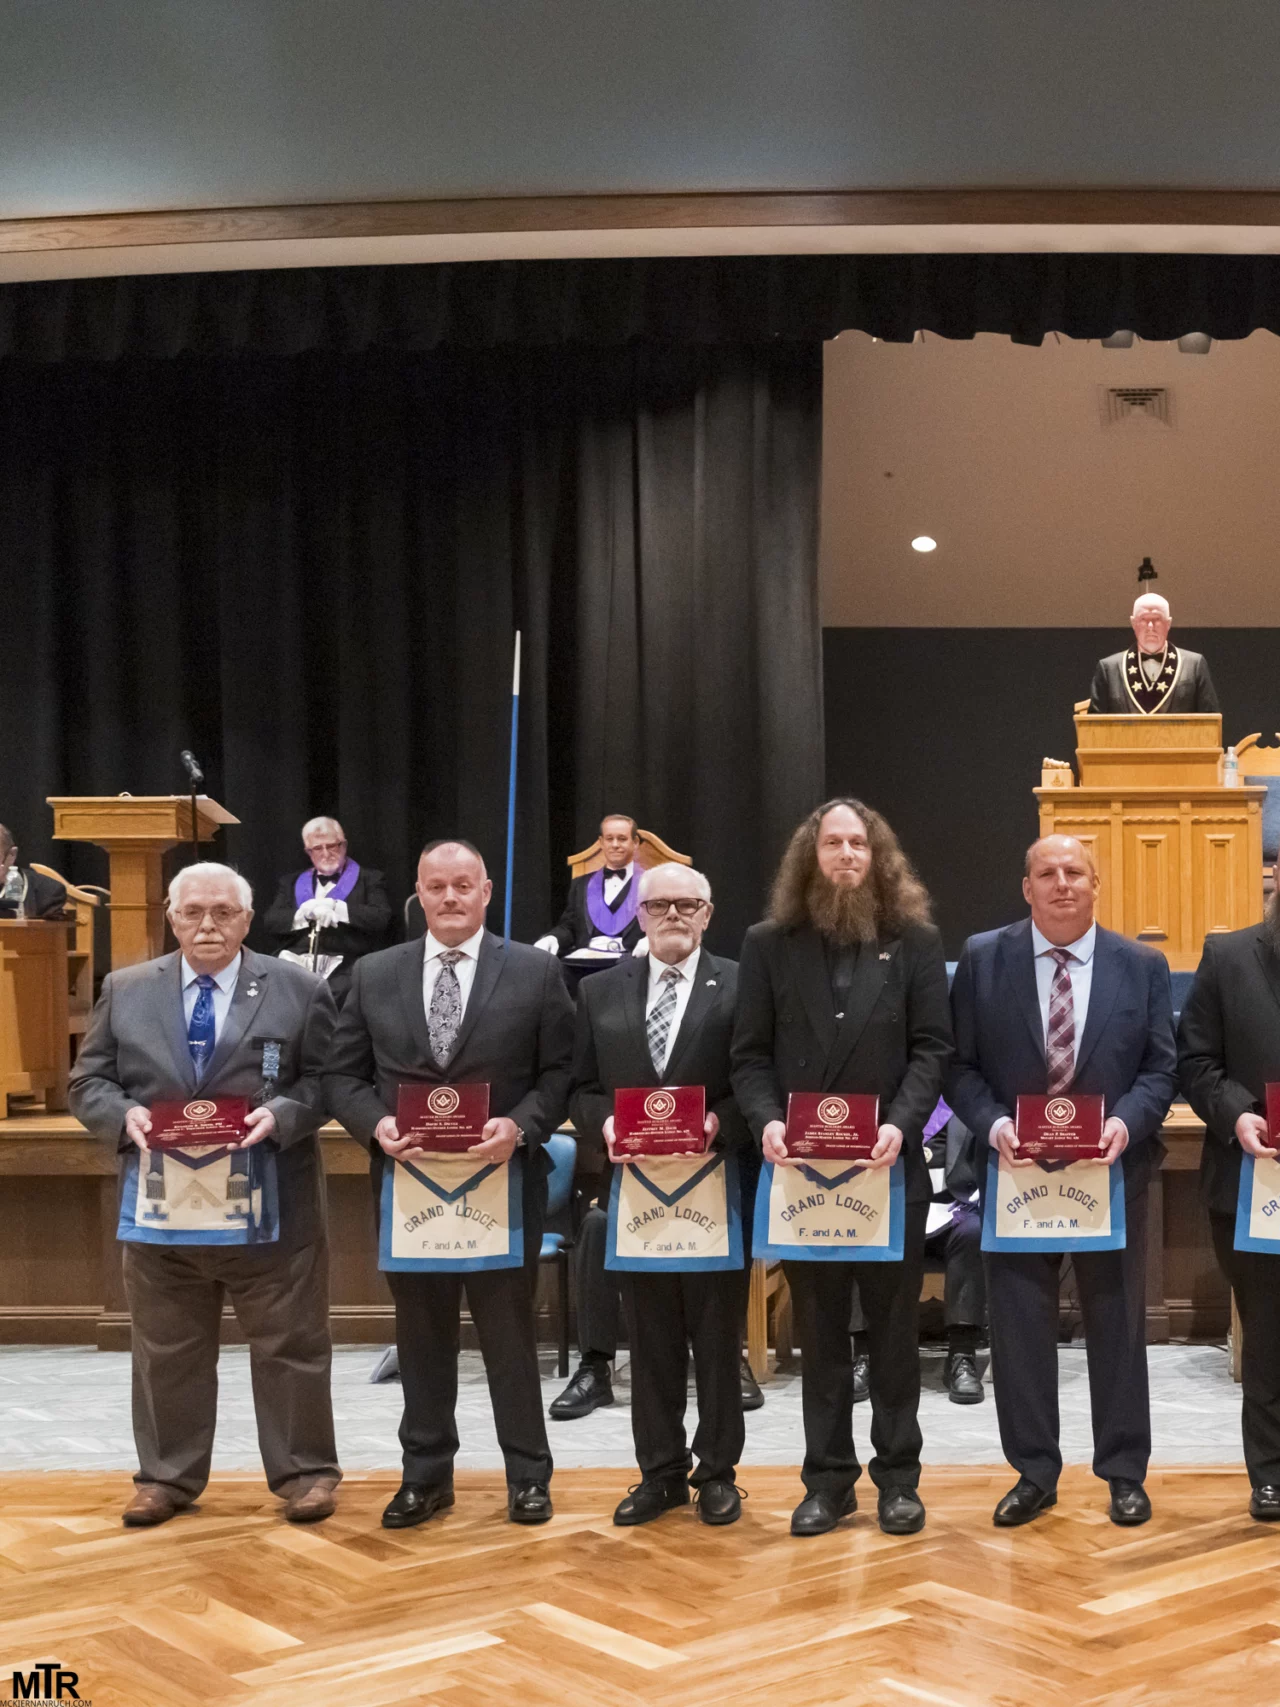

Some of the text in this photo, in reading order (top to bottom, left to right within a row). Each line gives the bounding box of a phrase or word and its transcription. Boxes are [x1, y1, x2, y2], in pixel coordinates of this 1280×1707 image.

[781, 1194, 878, 1222] GRAND LODGE
[1006, 1184, 1098, 1214] GRAND LODGE
[404, 1205, 498, 1232] GRAND LODGE
[627, 1205, 717, 1234] GRAND LODGE
[1024, 1219, 1080, 1229] F. and A. M.
[798, 1228, 858, 1238] F. and A. M.
[422, 1240, 478, 1250] F. and A. M.
[644, 1242, 697, 1251] F. and A. M.
